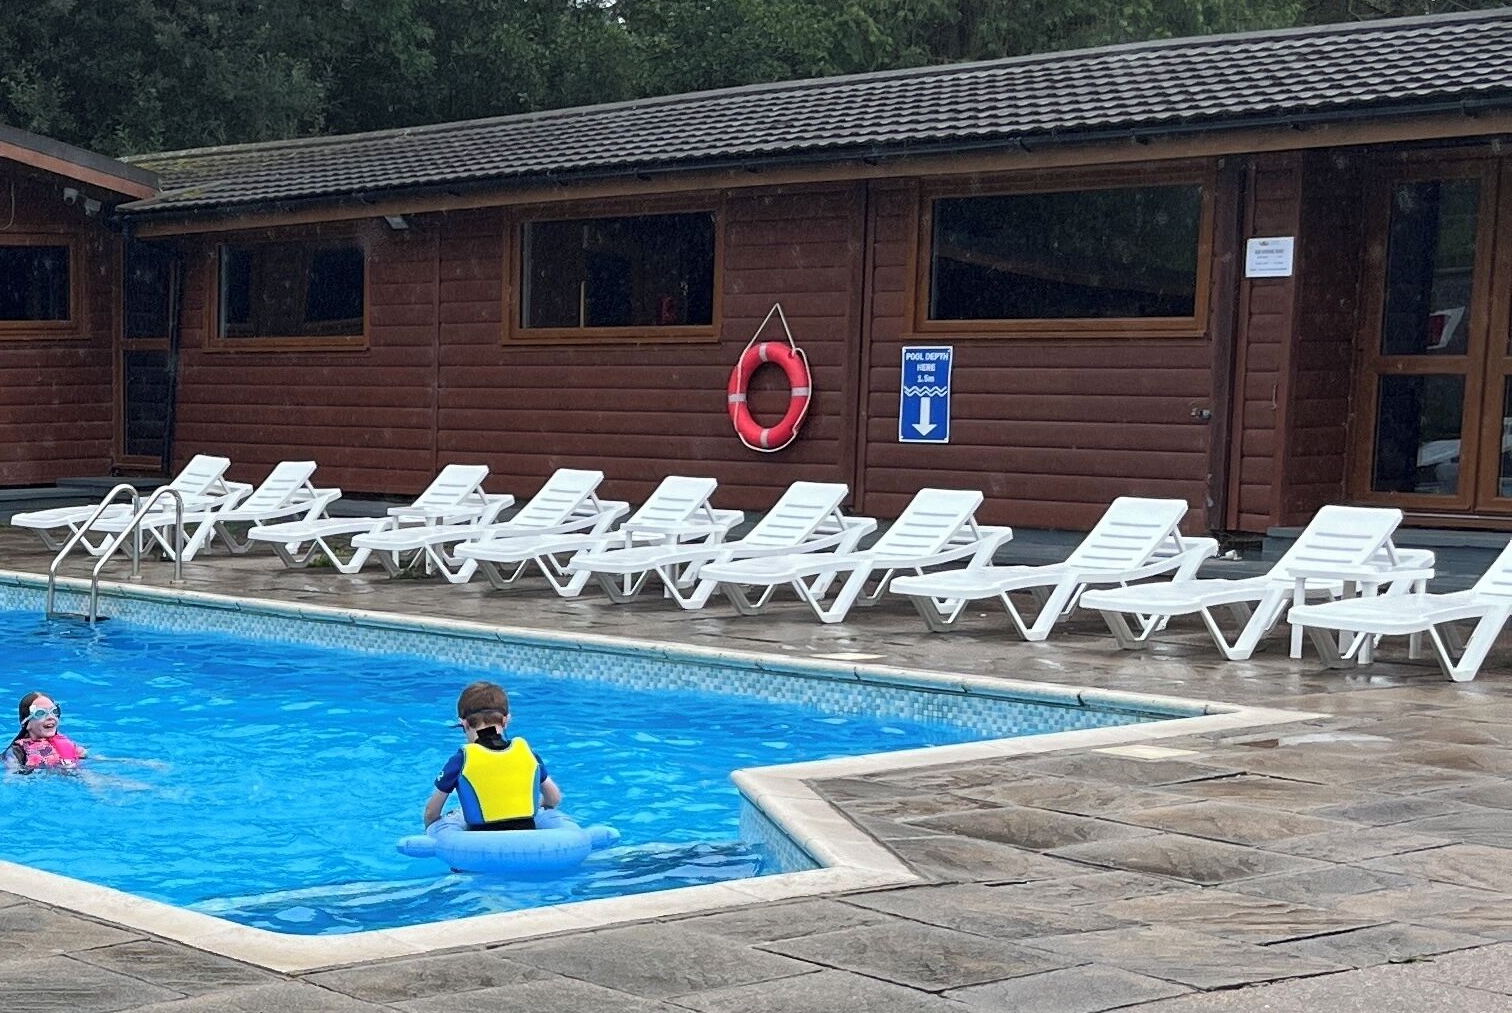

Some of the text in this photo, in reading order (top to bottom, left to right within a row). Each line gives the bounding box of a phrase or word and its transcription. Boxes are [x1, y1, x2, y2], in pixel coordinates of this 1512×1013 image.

[906, 352, 949, 361] POOL DEPTH
[916, 363, 936, 372] HERE
